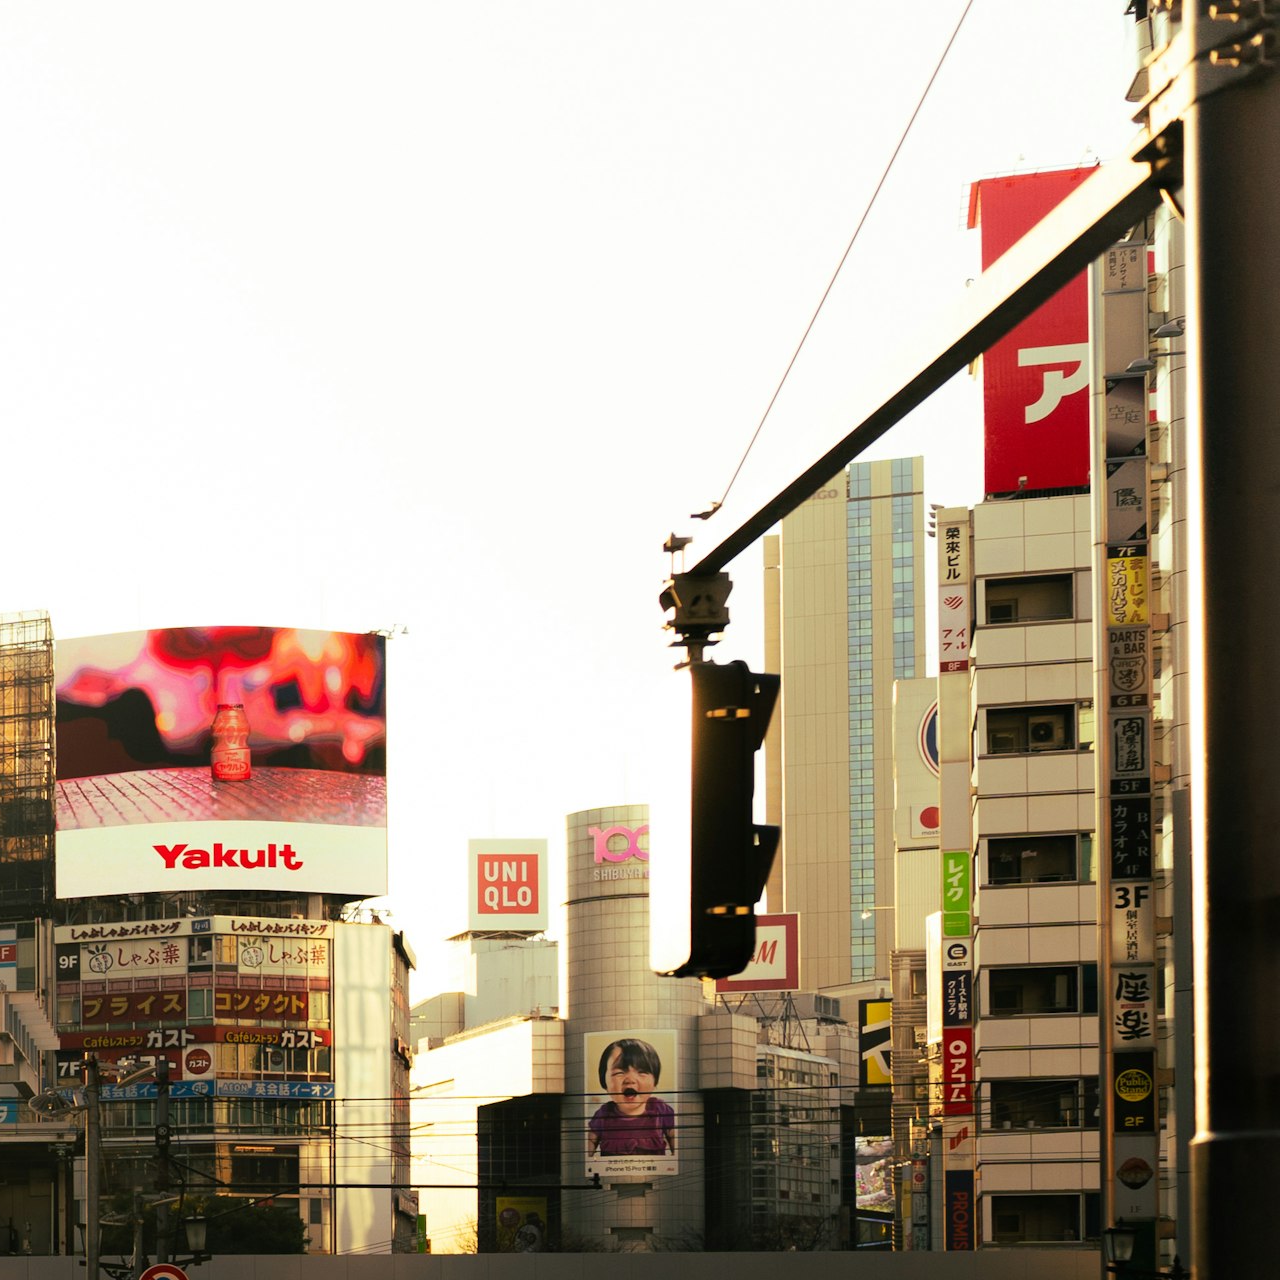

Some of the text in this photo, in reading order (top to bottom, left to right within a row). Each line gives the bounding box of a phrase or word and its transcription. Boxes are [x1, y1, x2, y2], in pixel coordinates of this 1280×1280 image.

[1117, 546, 1137, 557] 7F
[1110, 630, 1145, 644] DARTS
[1113, 643, 1145, 655] & BAR
[948, 662, 960, 672] 8F
[1116, 695, 1142, 706] 6F
[1119, 782, 1140, 792] 5F
[1114, 805, 1128, 864] カラオケ
[1137, 812, 1148, 857] BAR
[153, 843, 303, 871] Yakult
[484, 861, 528, 882] UNI
[594, 868, 641, 881] SHIBUYA
[947, 859, 964, 901] レイク
[484, 886, 532, 910] QLO
[1114, 886, 1149, 909] 3F
[71, 922, 181, 940] しゃぶしゃぶバイキング
[231, 920, 327, 936] しゃぶしゃぶバイキング
[1126, 909, 1139, 961] 個室居酒屋
[59, 955, 78, 969] 9F
[117, 944, 180, 966] しゃぶ葉
[269, 944, 326, 965] しゃぶ葉
[84, 994, 184, 1018] プライス
[215, 993, 305, 1013] コンタクト
[948, 980, 957, 1015] クリニック
[958, 975, 968, 1020] イースト駅前
[147, 1029, 195, 1048] ガスト
[281, 1030, 323, 1048] ガスト
[58, 1061, 80, 1077] 7F
[189, 1060, 209, 1068] ガスト
[255, 1083, 333, 1096] 英会話イーオン
[951, 1059, 966, 1102] アコム
[1120, 1077, 1149, 1087] Public
[1124, 1116, 1144, 1127] 2F
[953, 1192, 969, 1250] PROMIS
